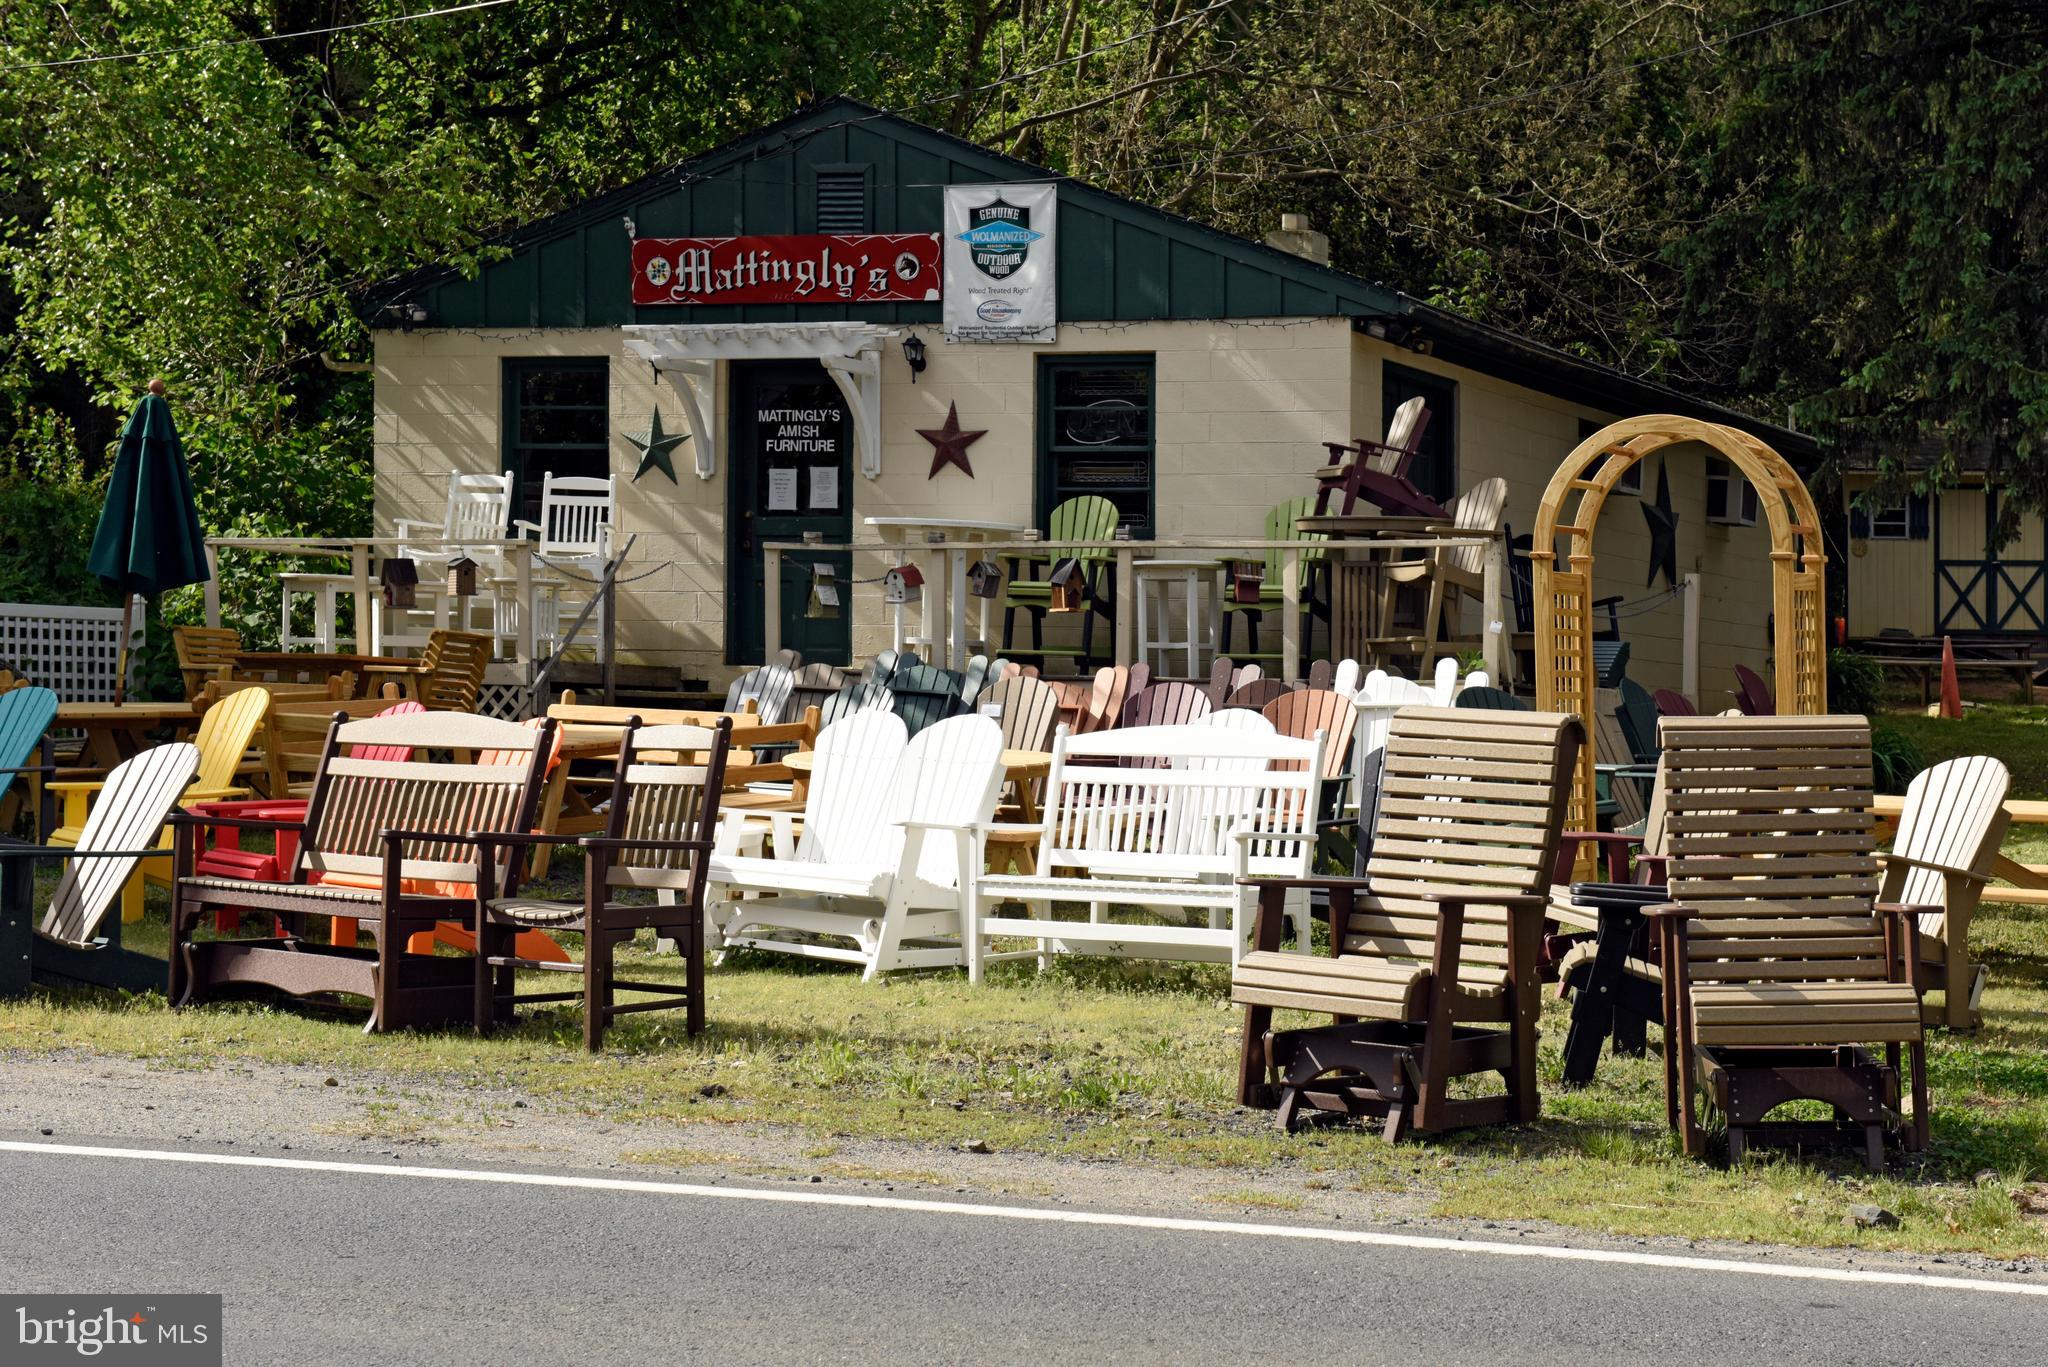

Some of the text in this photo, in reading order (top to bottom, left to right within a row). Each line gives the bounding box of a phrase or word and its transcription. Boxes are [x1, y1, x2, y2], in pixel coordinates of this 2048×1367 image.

[979, 207, 1020, 220] GENUINE
[977, 252, 1021, 266] OUTDOOR
[670, 247, 888, 301] Mattingly's
[989, 265, 1010, 275] WOOD
[758, 409, 841, 423] MATTINGLY'S
[777, 424, 820, 438] AMISH
[766, 439, 836, 452] FURNITURE
